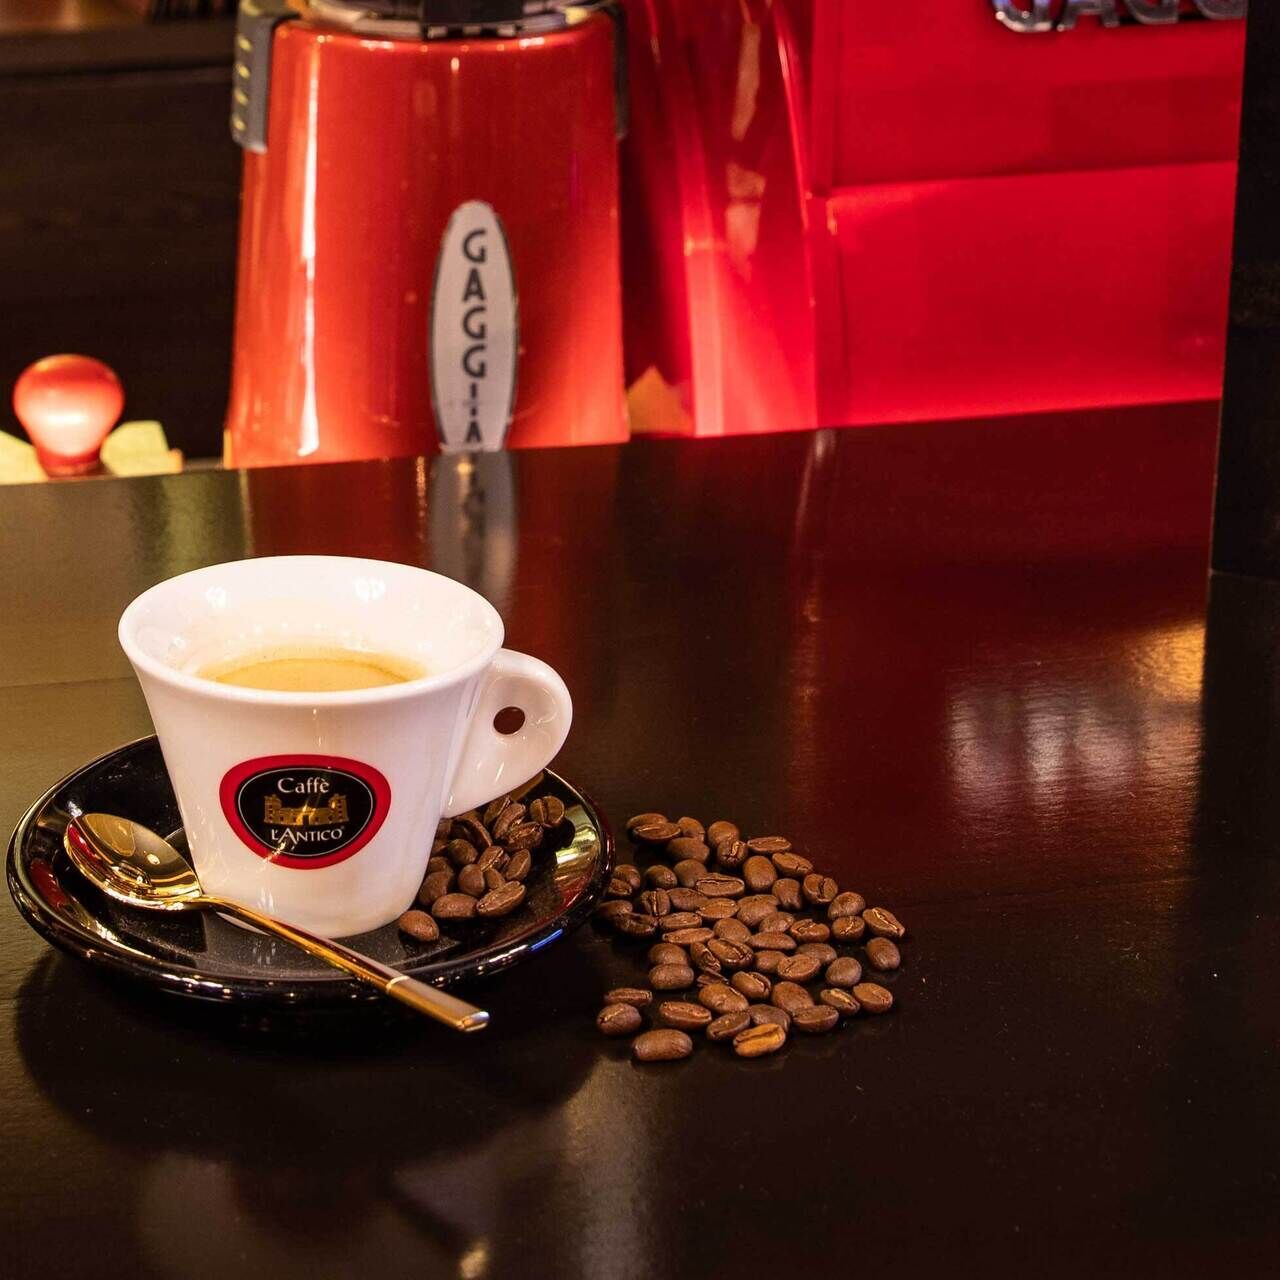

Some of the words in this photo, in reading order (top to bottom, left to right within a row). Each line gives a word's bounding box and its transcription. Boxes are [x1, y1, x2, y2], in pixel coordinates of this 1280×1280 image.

[461, 228, 487, 444] GAGGIA
[278, 777, 330, 794] Caffè
[271, 828, 343, 843] L'ANTICO
